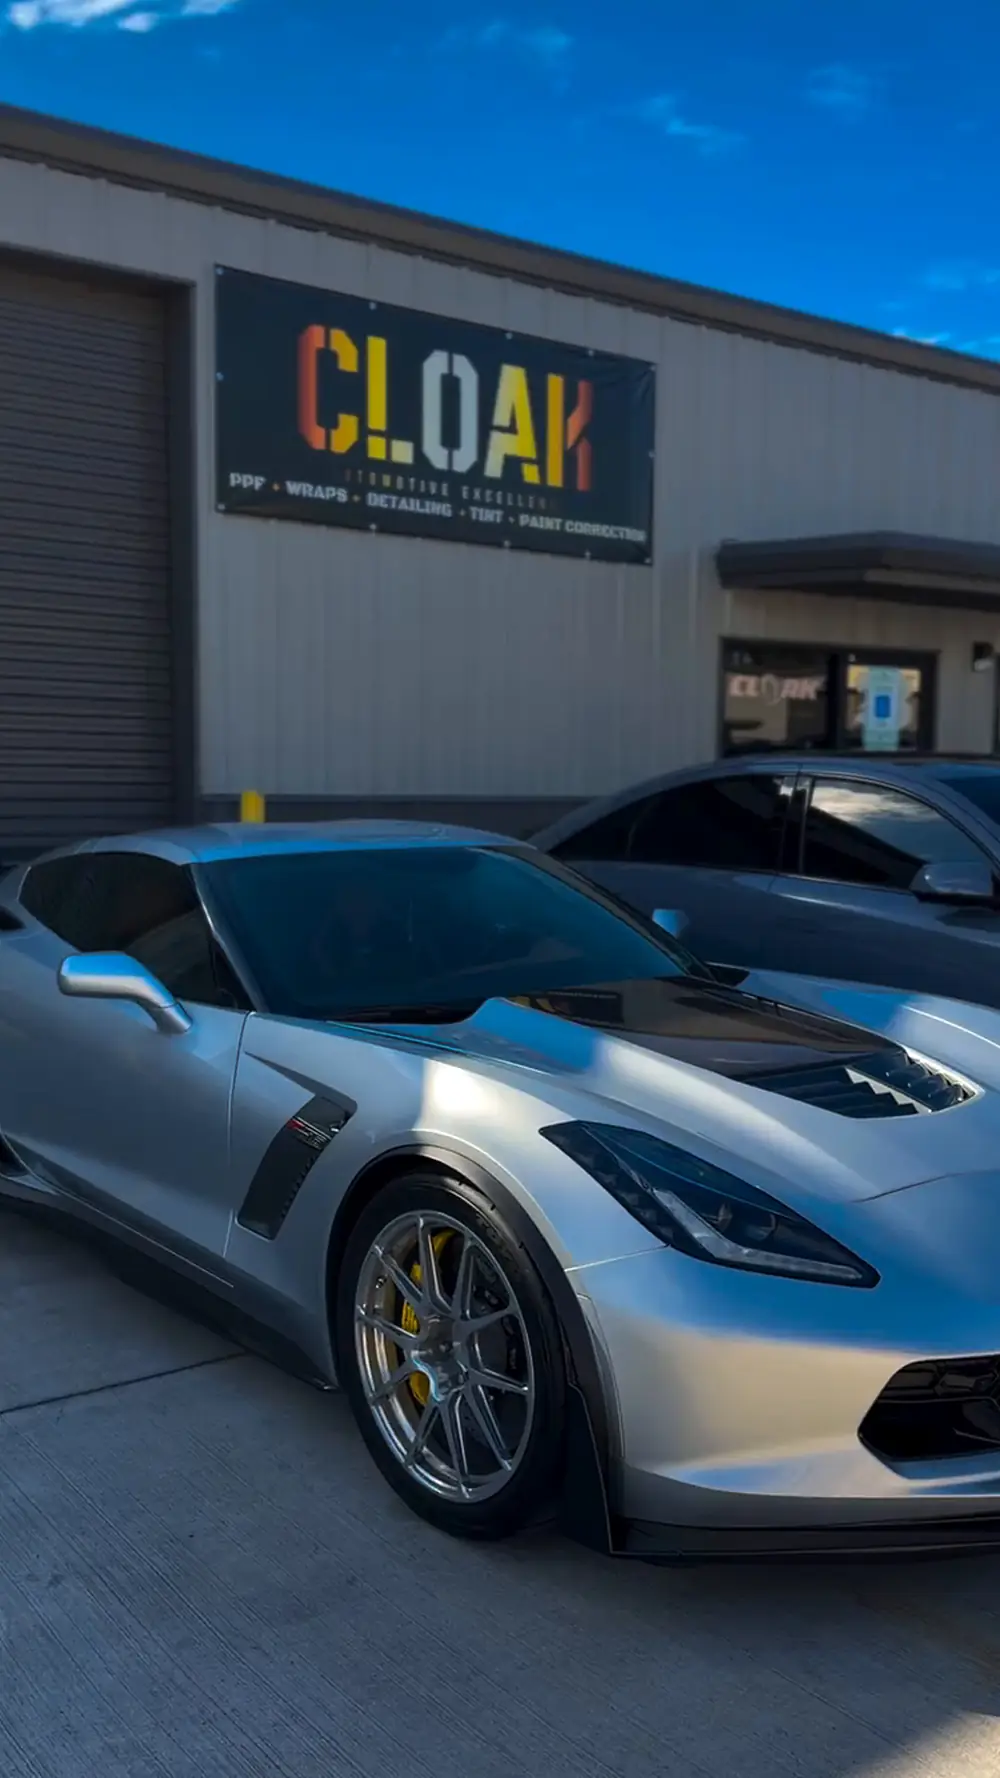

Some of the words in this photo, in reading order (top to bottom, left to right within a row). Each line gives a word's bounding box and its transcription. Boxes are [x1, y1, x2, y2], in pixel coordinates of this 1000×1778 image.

[298, 324, 593, 491] CLOAK
[229, 472, 267, 492] PPF
[284, 480, 349, 503] WRAPS
[367, 492, 453, 518] DETAILING
[469, 506, 505, 525] TINT
[518, 513, 564, 532] PAINT
[564, 520, 647, 543] CORRECTION
[344, 468, 449, 497] TOMOTIVE
[461, 485, 550, 510] EXCELLEN
